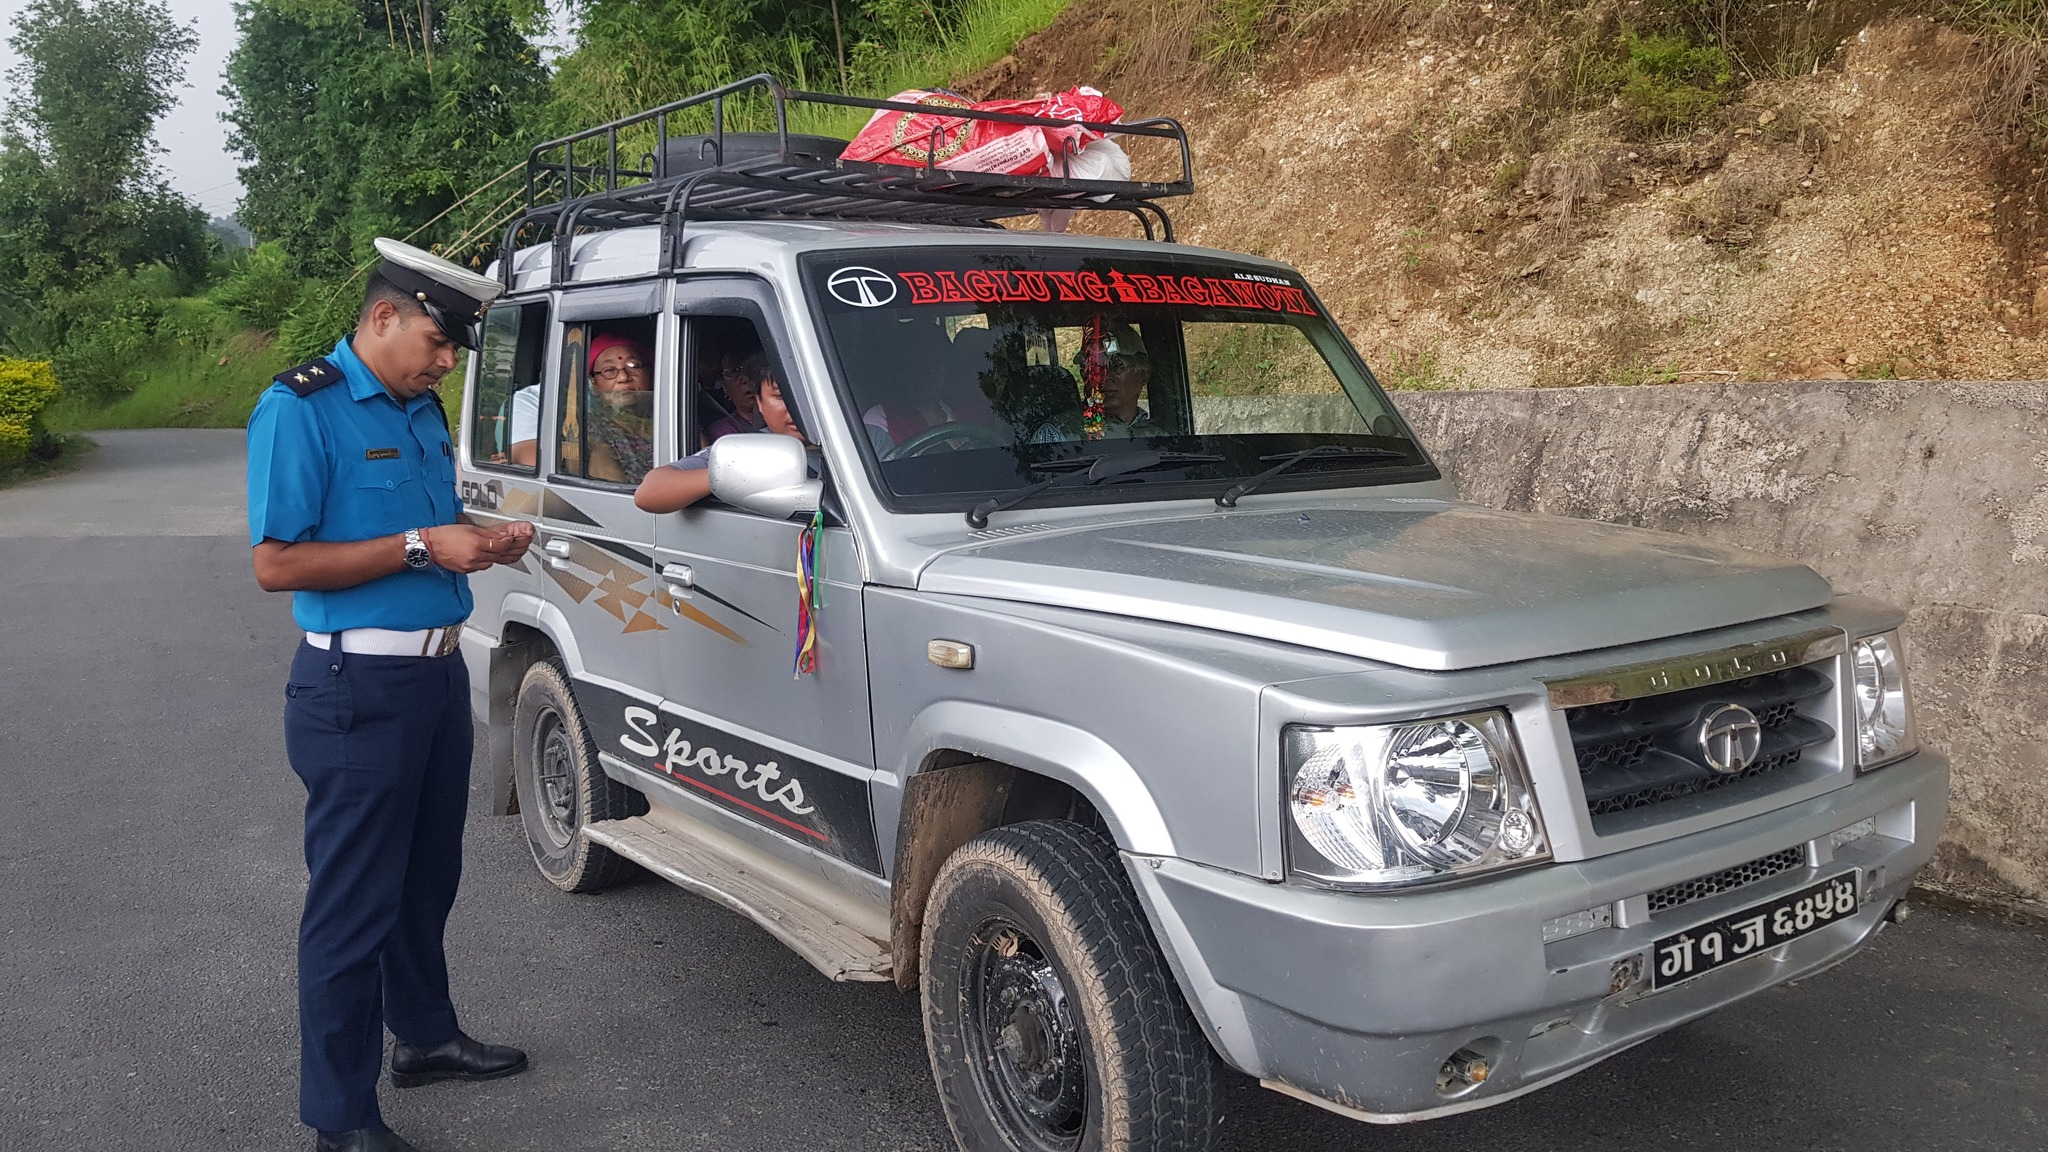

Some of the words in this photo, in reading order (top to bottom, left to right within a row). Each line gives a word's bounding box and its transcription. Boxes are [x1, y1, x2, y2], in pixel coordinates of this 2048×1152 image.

[897, 270, 1111, 304] BAGLUNG
[461, 480, 497, 509] GOLD
[620, 706, 814, 814] Sports
